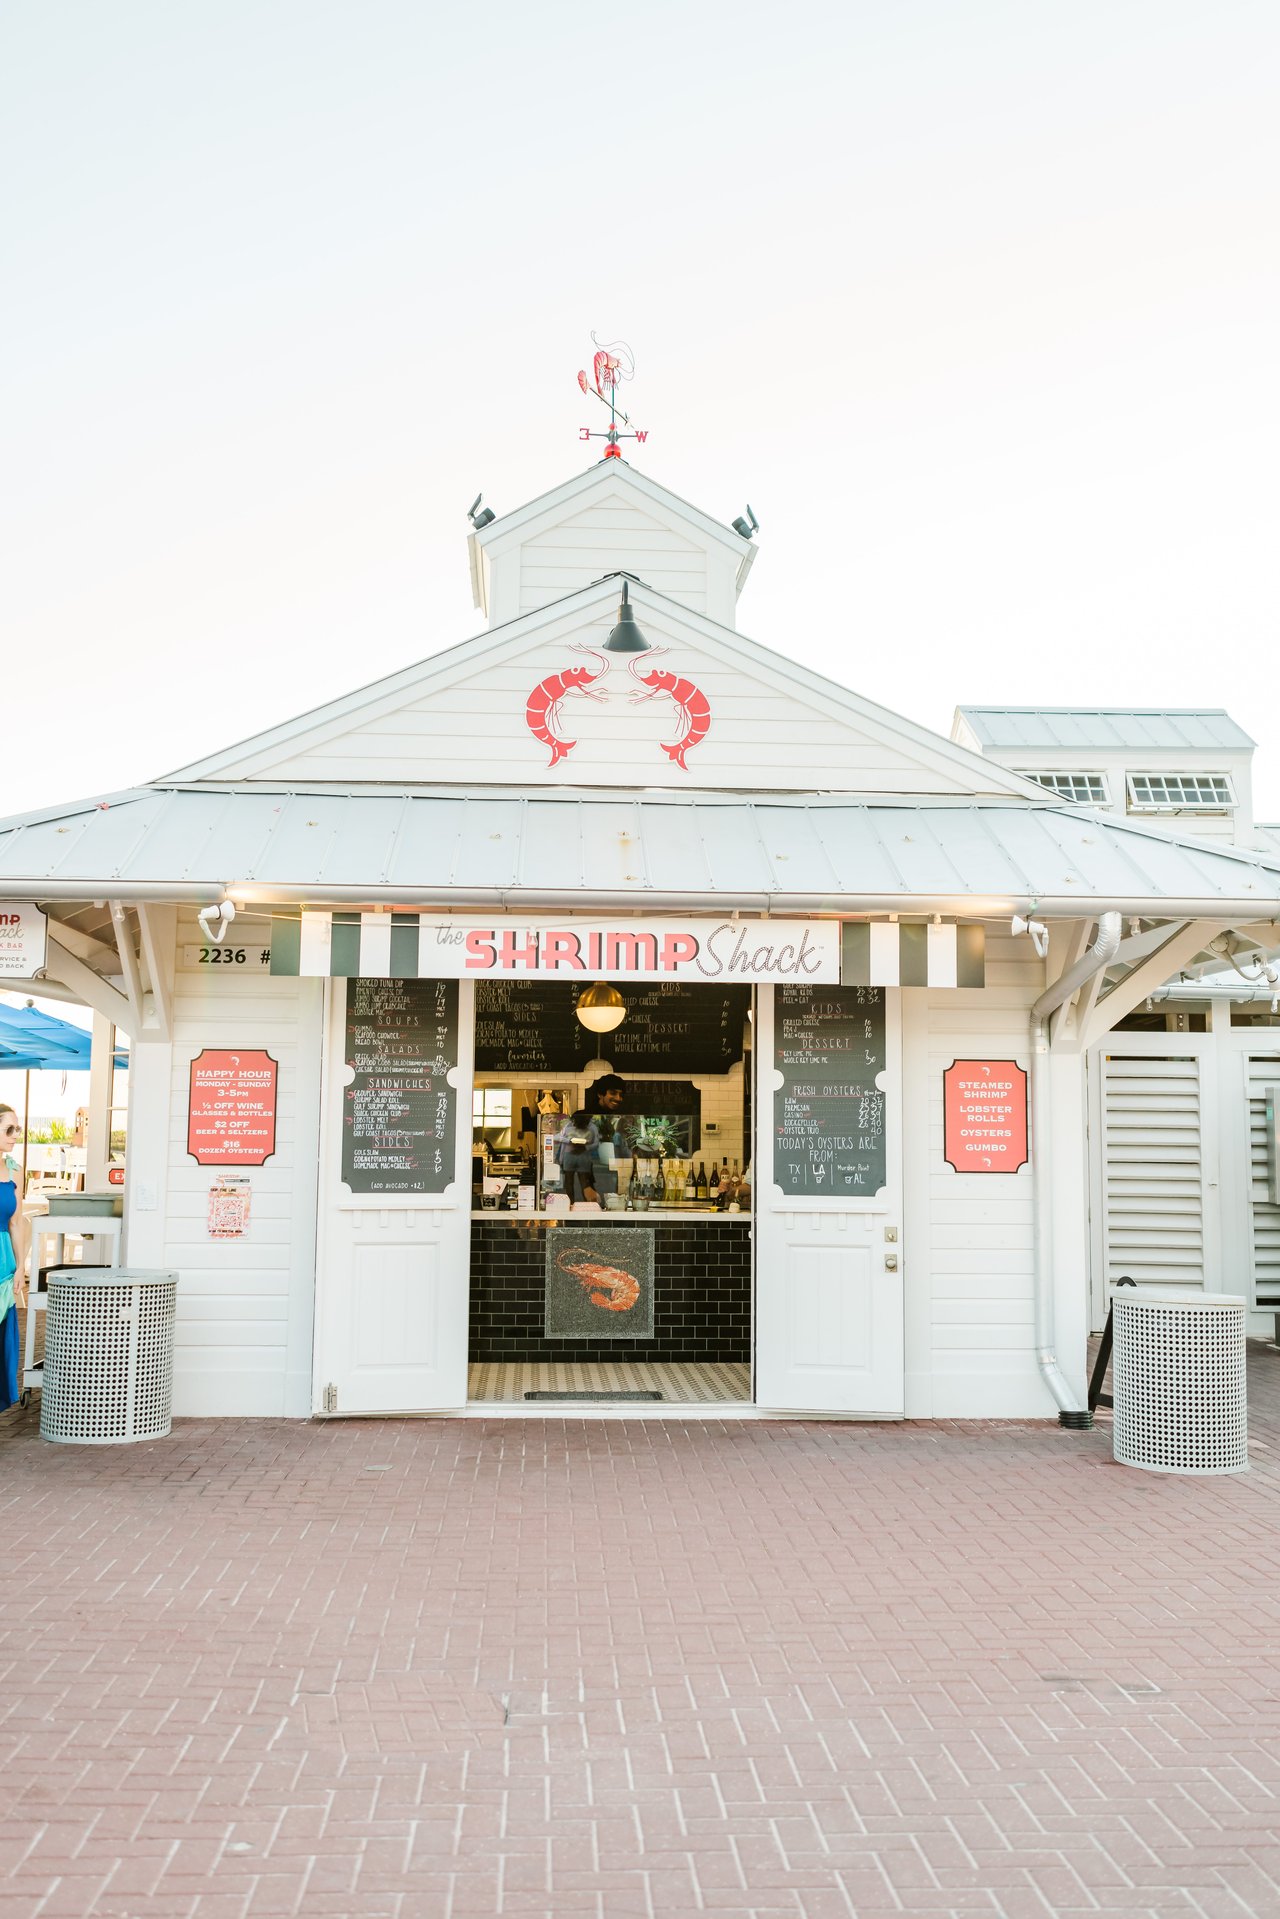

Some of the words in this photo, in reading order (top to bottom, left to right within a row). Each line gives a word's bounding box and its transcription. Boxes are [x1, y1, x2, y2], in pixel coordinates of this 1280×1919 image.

[635, 431, 648, 442] W
[435, 923, 464, 945] the
[465, 930, 699, 971] SHRIMP
[696, 923, 822, 977] Shack
[199, 948, 246, 964] 2236
[661, 982, 680, 992] KIDS
[812, 1004, 841, 1014] KIDS
[378, 1016, 419, 1025] SOUPS
[514, 1012, 536, 1021] SIDES
[648, 1024, 688, 1033] DESSERT
[803, 1039, 849, 1048] DESSERT
[508, 1050, 545, 1062] favorites
[368, 1079, 430, 1088] SANDWICHES
[793, 1085, 816, 1095] FRESH
[823, 1086, 860, 1096] OYSTERS
[375, 1137, 409, 1147] SIDES
[777, 1137, 813, 1150] TODAY'S
[818, 1137, 853, 1149] OYSTERS
[859, 1136, 877, 1150] ARE
[809, 1150, 837, 1162] FROM:
[788, 1164, 800, 1174] TX
[812, 1164, 825, 1175] LA
[854, 1173, 865, 1184] AL
